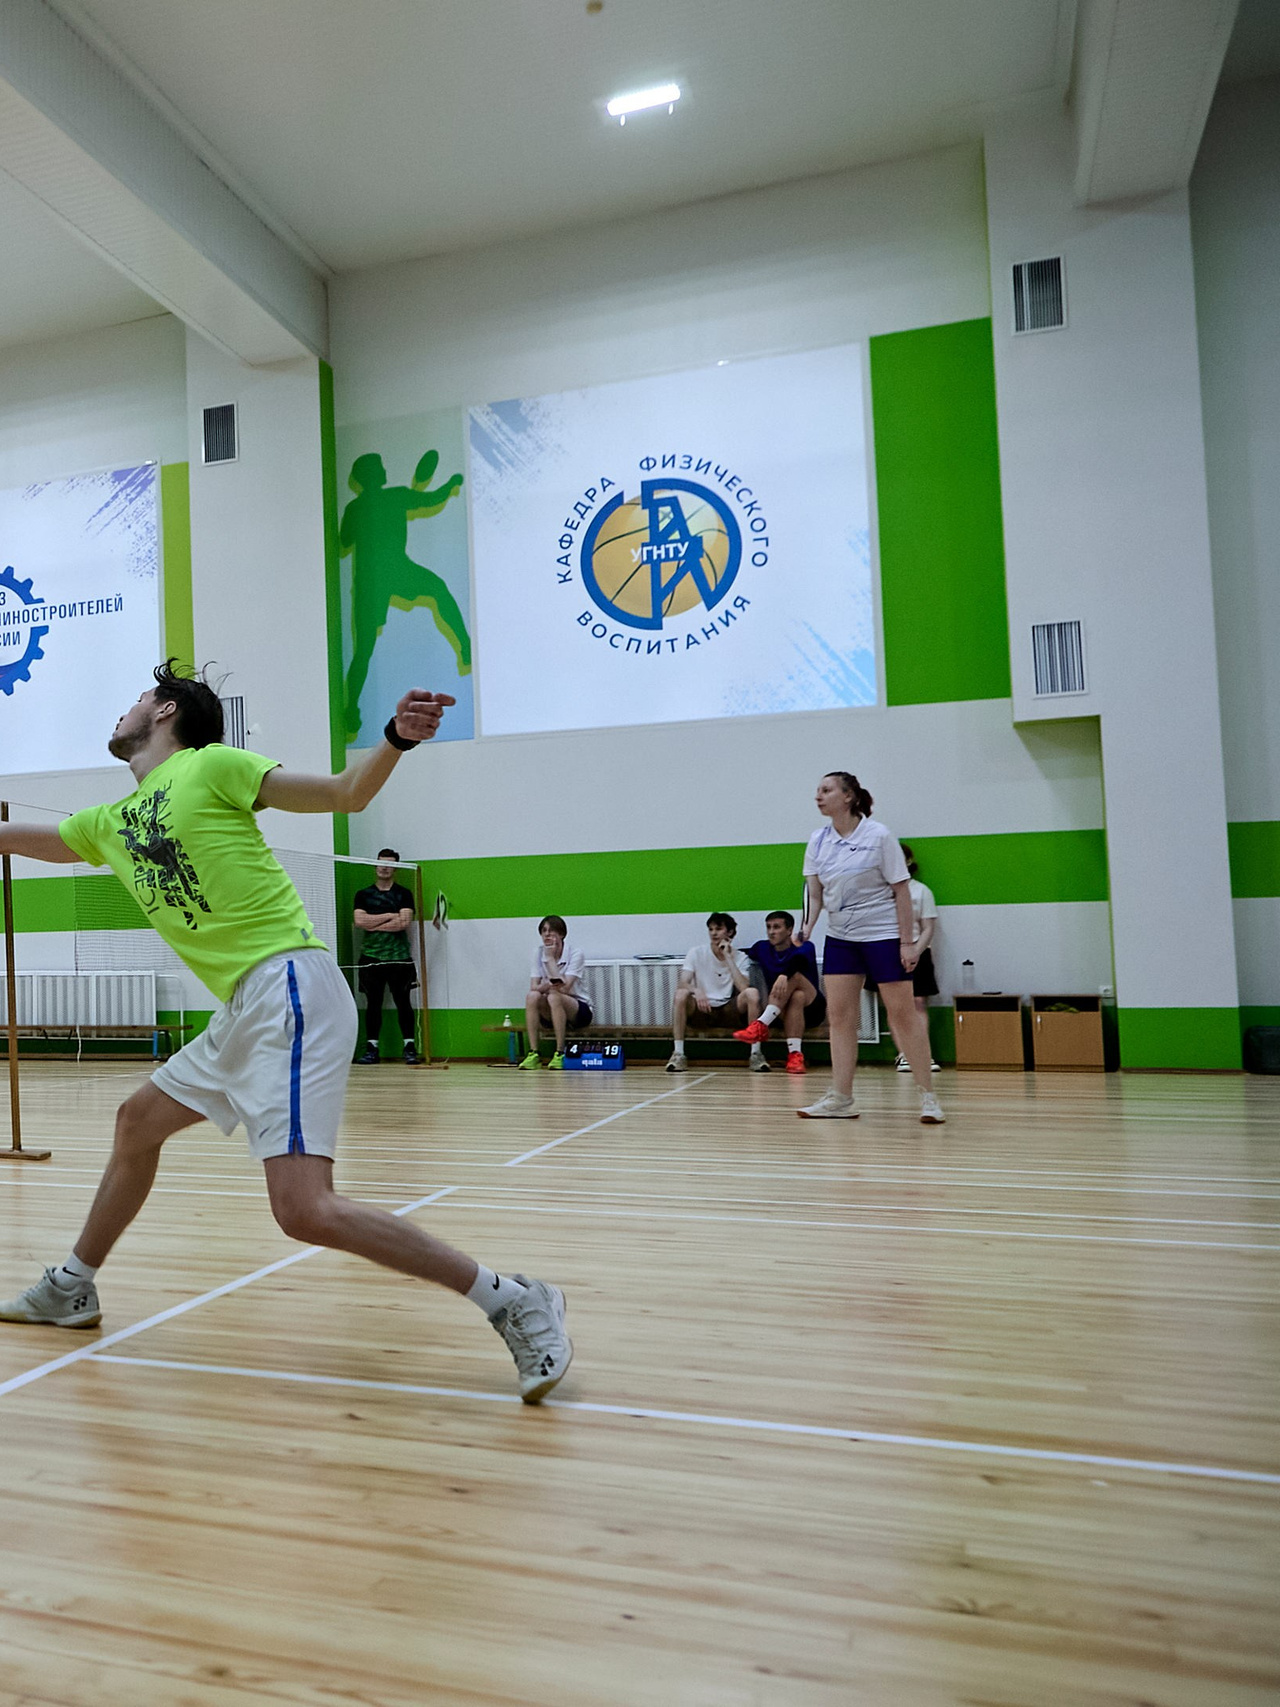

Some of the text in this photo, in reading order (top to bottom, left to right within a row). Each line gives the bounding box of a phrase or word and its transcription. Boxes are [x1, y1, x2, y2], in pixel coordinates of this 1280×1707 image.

[557, 453, 770, 584] КАФЕДРА ФИЗИЧЕСКОГО
[630, 541, 690, 563] УГНТУ
[576, 595, 751, 655] ВОСПИТАНИЯ
[570, 1044, 578, 1053] 4
[604, 1045, 619, 1055] 19
